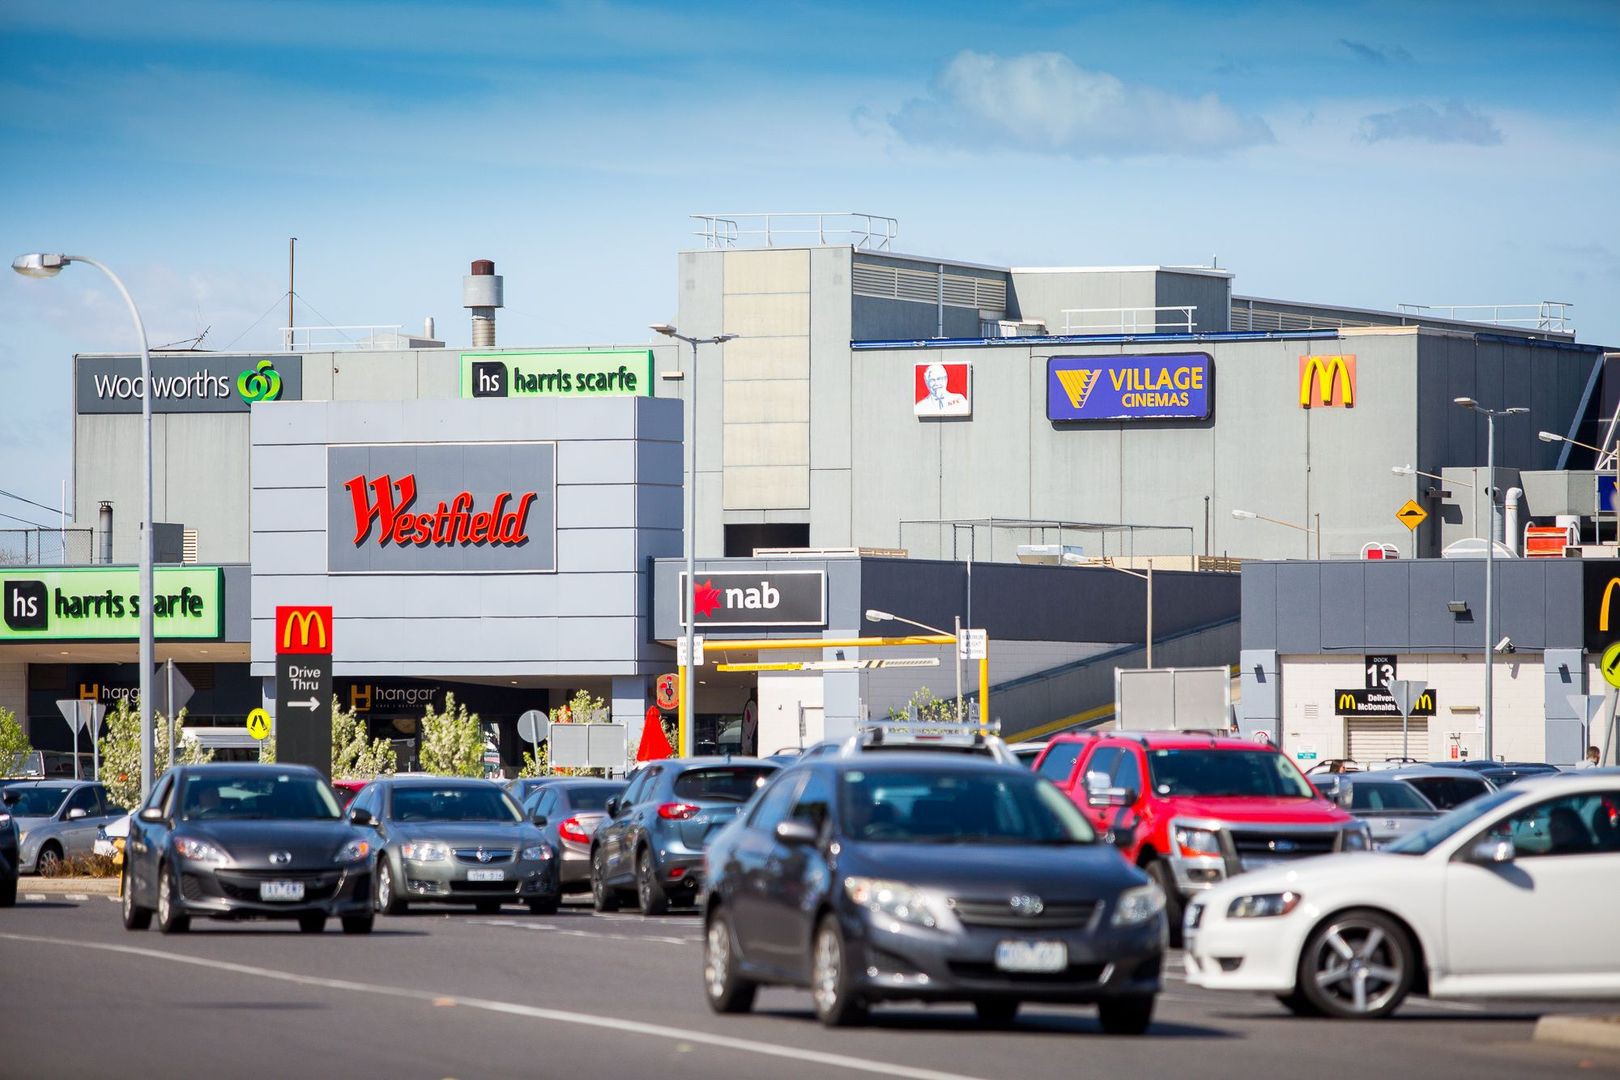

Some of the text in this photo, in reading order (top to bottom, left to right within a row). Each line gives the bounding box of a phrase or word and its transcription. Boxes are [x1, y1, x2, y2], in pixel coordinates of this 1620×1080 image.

[94, 369, 230, 398] Wooworths
[479, 368, 500, 392] hs
[514, 366, 638, 392] harris scarfe
[1108, 367, 1203, 391] VILLAGE
[1121, 392, 1189, 408] CINEMAS
[344, 474, 538, 545] Westfield
[13, 588, 38, 617] hs
[55, 587, 204, 618] harris sarfe
[725, 582, 780, 609] nab
[288, 666, 321, 679] Drive
[291, 678, 319, 691] Thru
[1367, 664, 1395, 687] 13
[103, 685, 141, 703] hang
[376, 686, 436, 704] hangar
[1358, 703, 1395, 711] McDonalds
